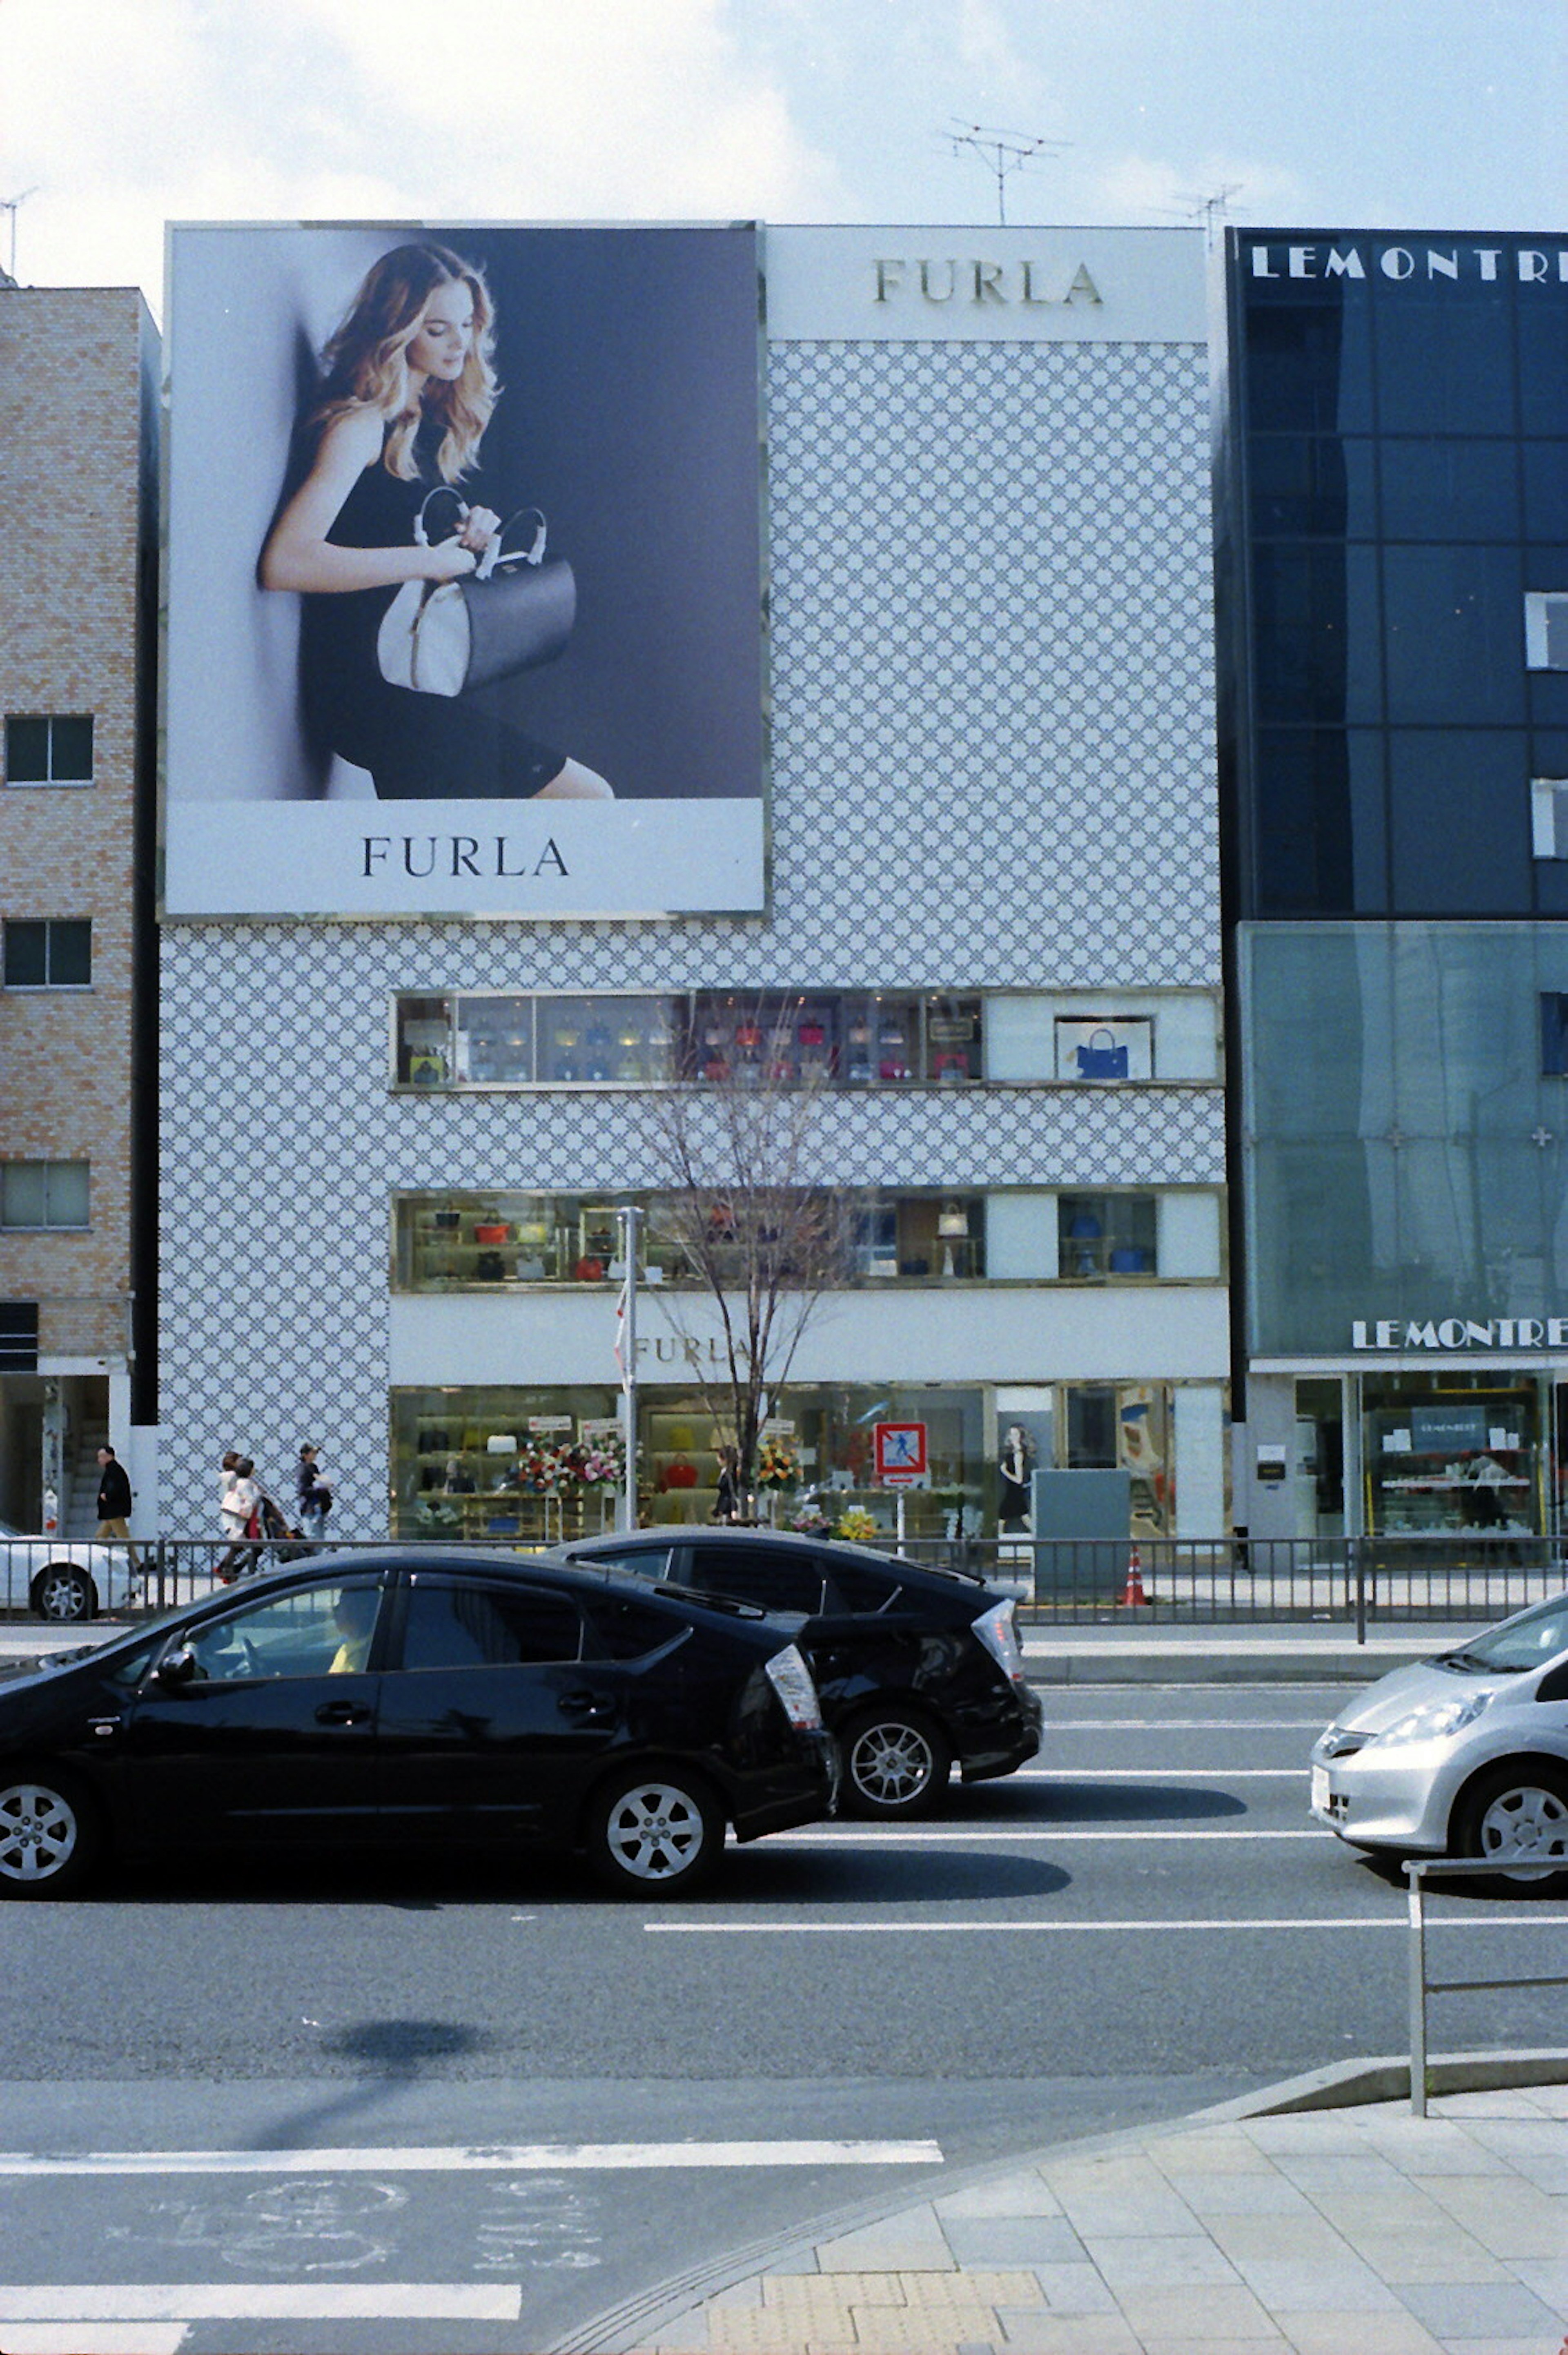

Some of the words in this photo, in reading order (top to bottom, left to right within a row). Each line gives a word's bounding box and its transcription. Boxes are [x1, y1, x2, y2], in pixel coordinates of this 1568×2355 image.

[873, 259, 1103, 303] FURLA
[361, 837, 569, 877] FURLA
[1353, 1318, 1568, 1348] LEMONTRE
